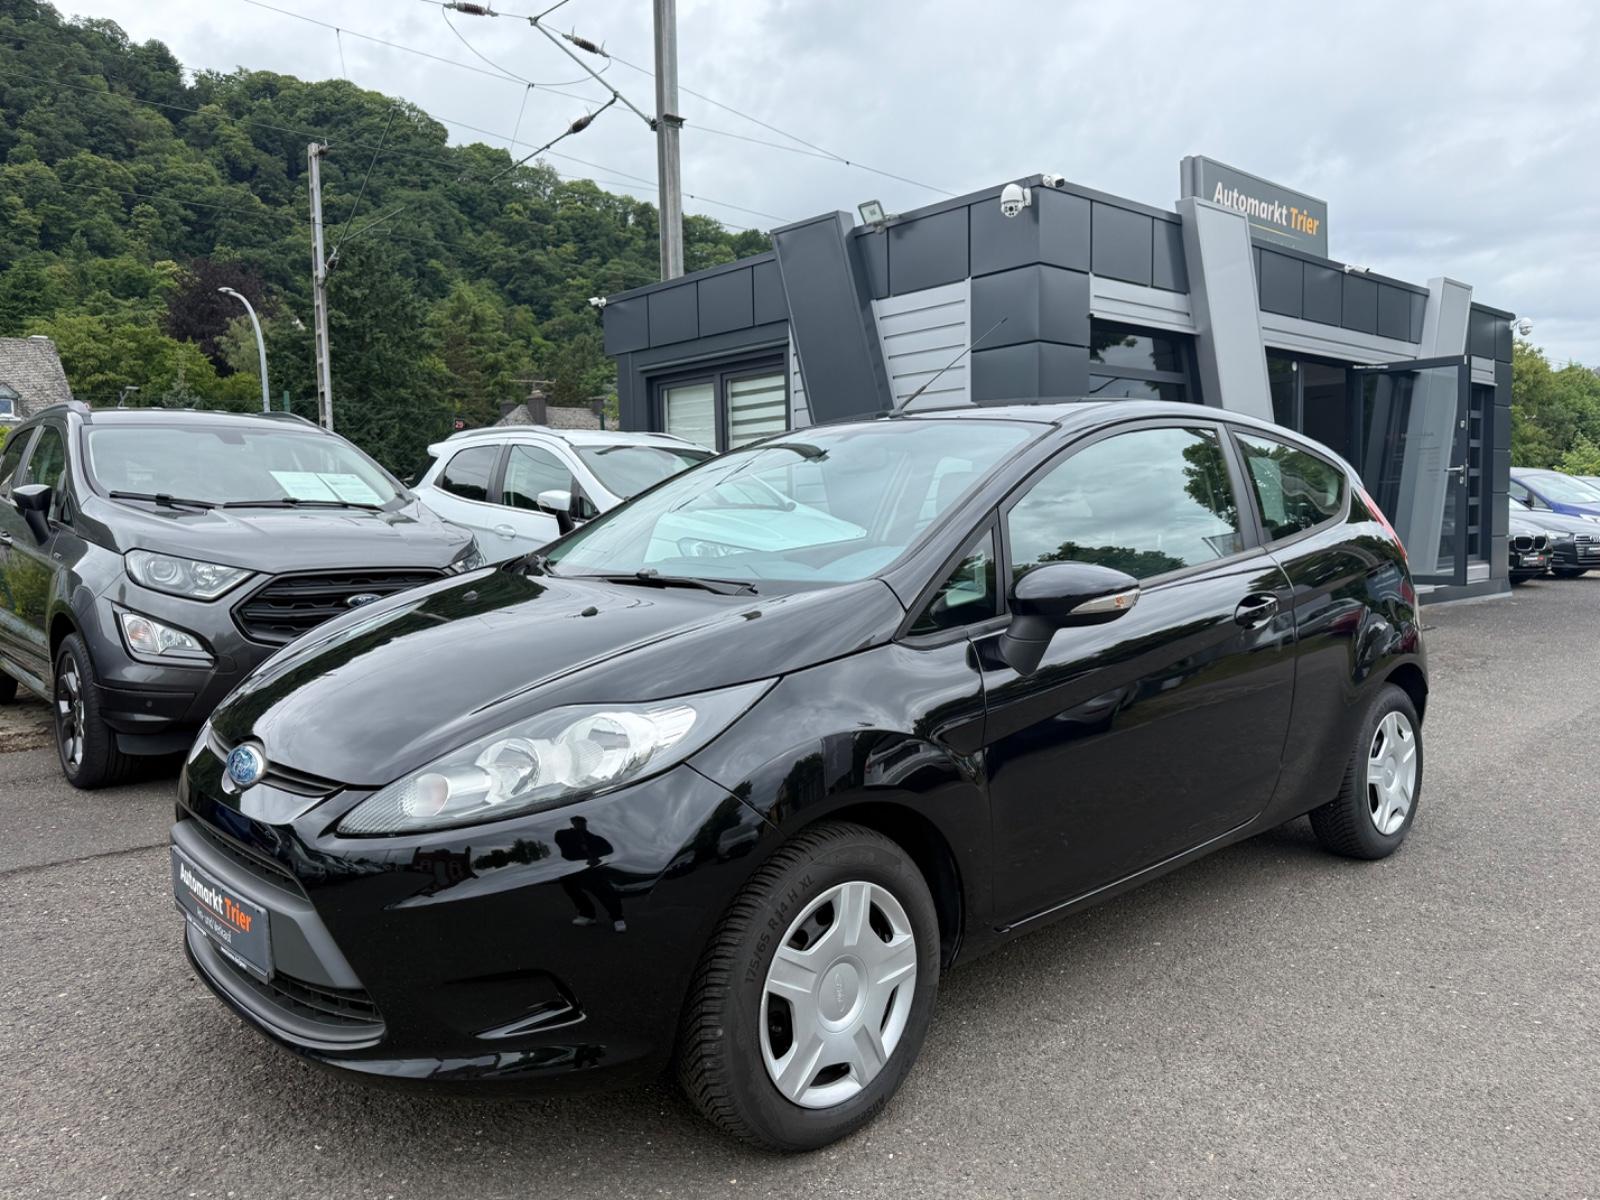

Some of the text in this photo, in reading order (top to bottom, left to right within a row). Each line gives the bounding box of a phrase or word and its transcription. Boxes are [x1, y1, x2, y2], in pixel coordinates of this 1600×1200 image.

[1213, 182, 1320, 236] Automarkt Trier
[180, 862, 224, 915] Automarkt
[224, 897, 252, 933] Trier
[744, 931, 771, 984] 175/65
[798, 874, 816, 891] XL
